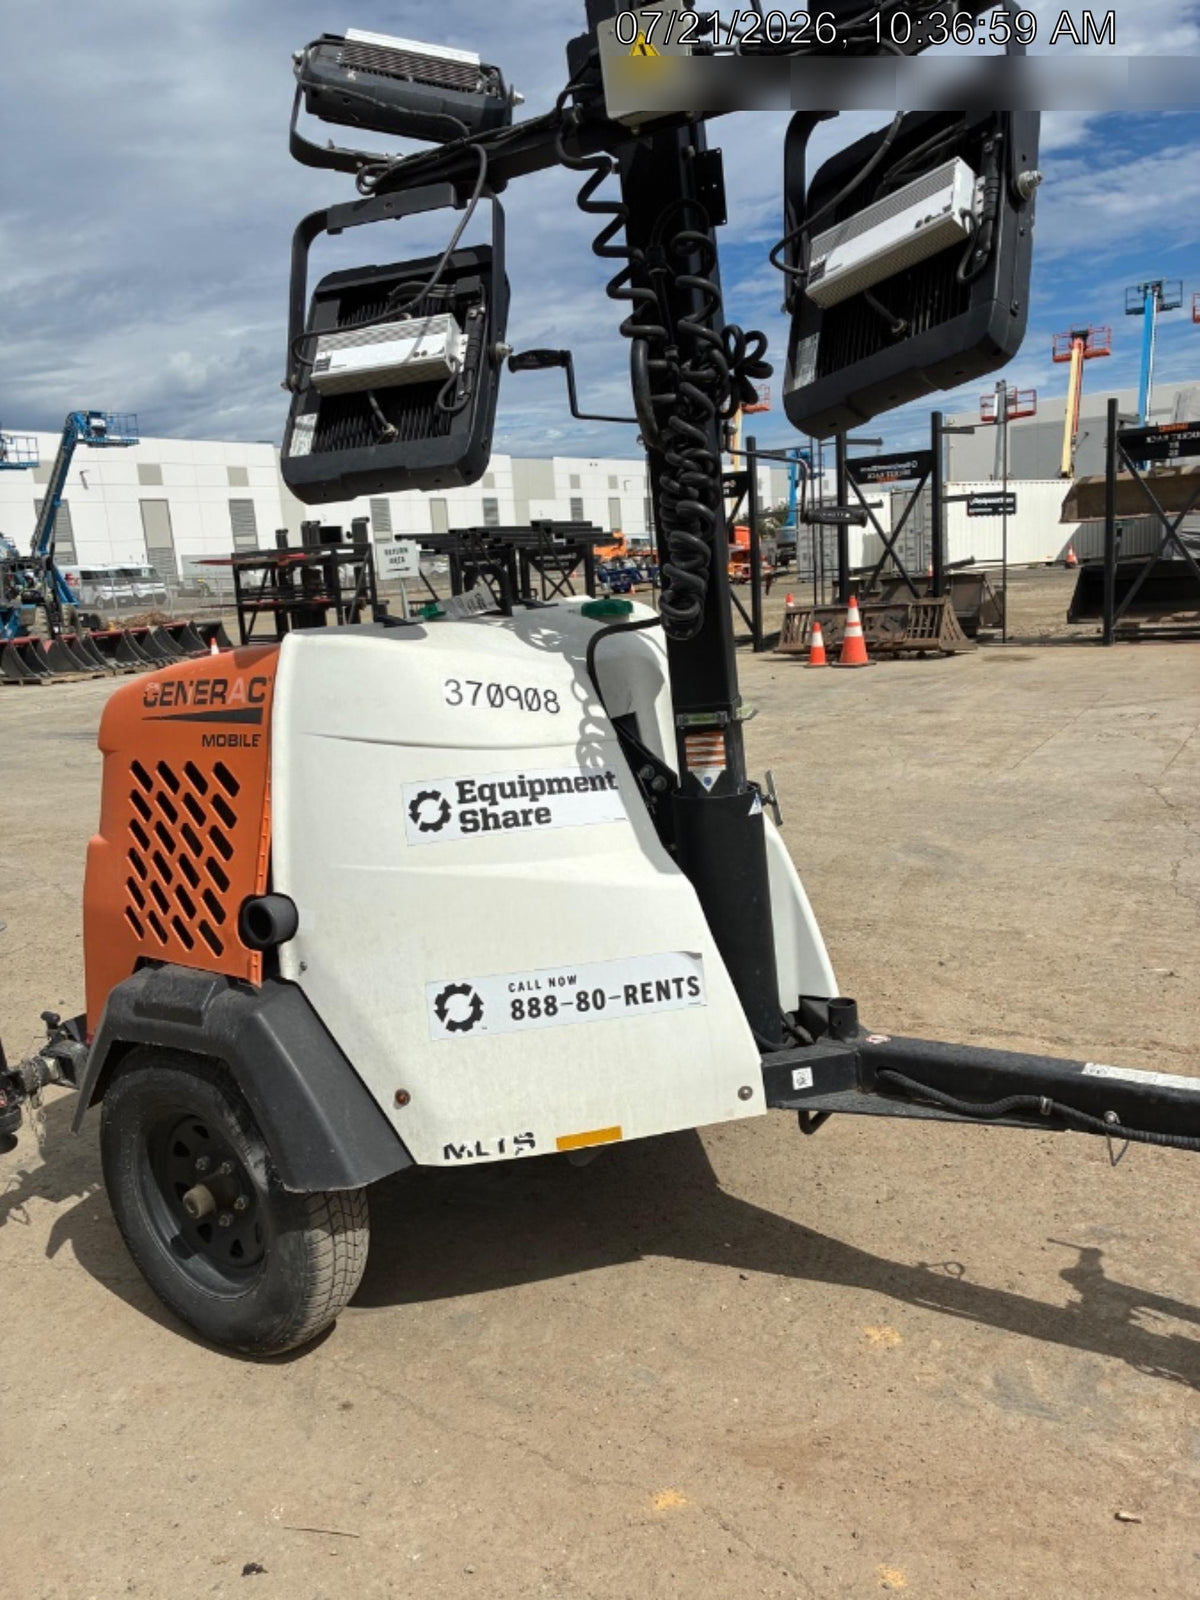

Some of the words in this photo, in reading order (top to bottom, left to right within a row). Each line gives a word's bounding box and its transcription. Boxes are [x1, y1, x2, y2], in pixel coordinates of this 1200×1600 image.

[143, 677, 267, 707] GENERAC
[444, 679, 560, 714] 370908
[202, 734, 261, 748] MOBILE
[455, 771, 619, 806] Equipment
[459, 806, 552, 834] Share
[507, 980, 542, 993] CALL
[548, 975, 578, 988] NOW
[510, 975, 701, 1021] 888-80-RENTS
